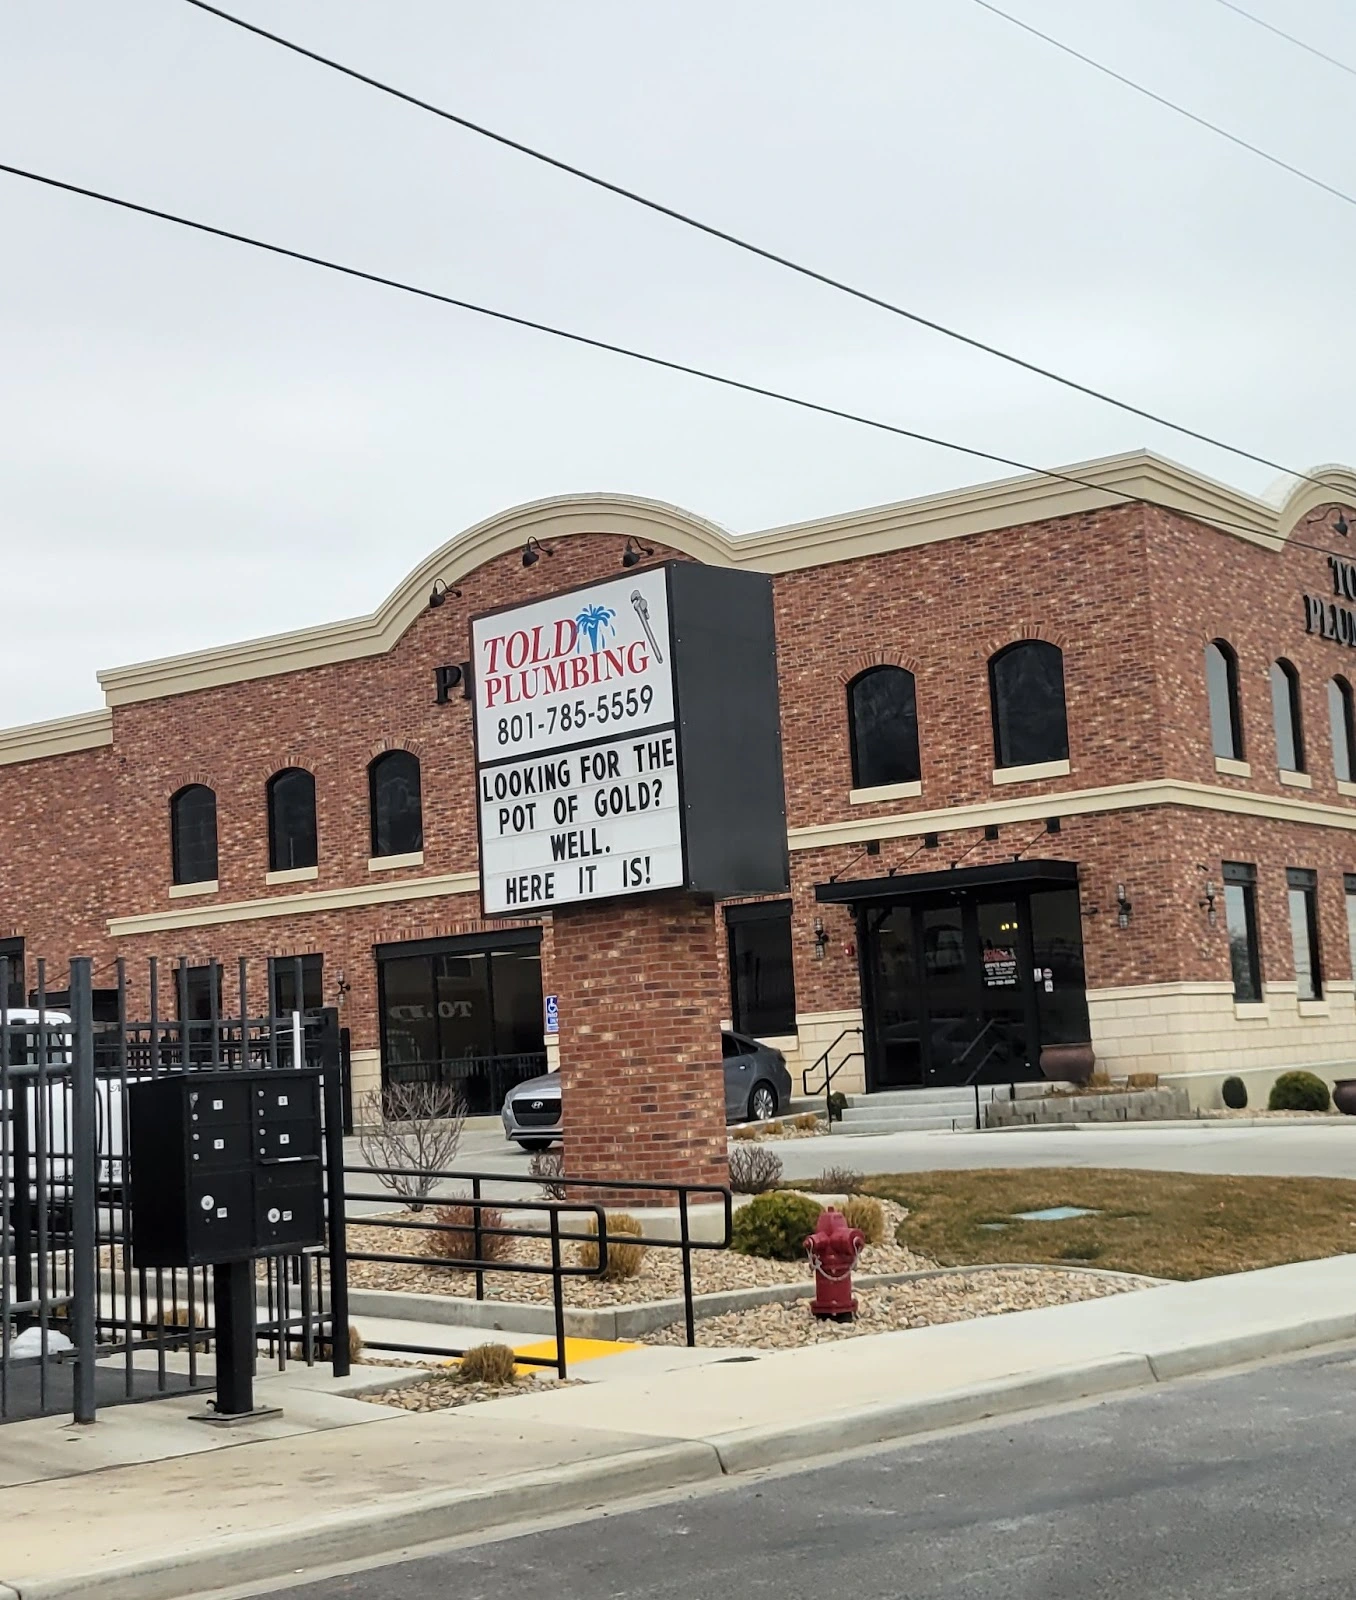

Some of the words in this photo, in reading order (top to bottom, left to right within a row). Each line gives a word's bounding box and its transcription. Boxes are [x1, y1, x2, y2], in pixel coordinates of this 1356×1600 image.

[484, 618, 578, 675] TOLD
[485, 640, 650, 709] PLUMBING
[497, 684, 654, 745] 801-785-5559
[483, 759, 570, 802] LOOKING
[580, 750, 621, 783] FOR
[633, 737, 674, 772] THE
[499, 803, 536, 835] POT
[553, 794, 578, 825] OF
[595, 778, 663, 817] GOLD?
[550, 828, 610, 862] WELL.
[506, 872, 555, 905] HERE
[579, 865, 597, 894] IT
[622, 856, 651, 887] IS!
